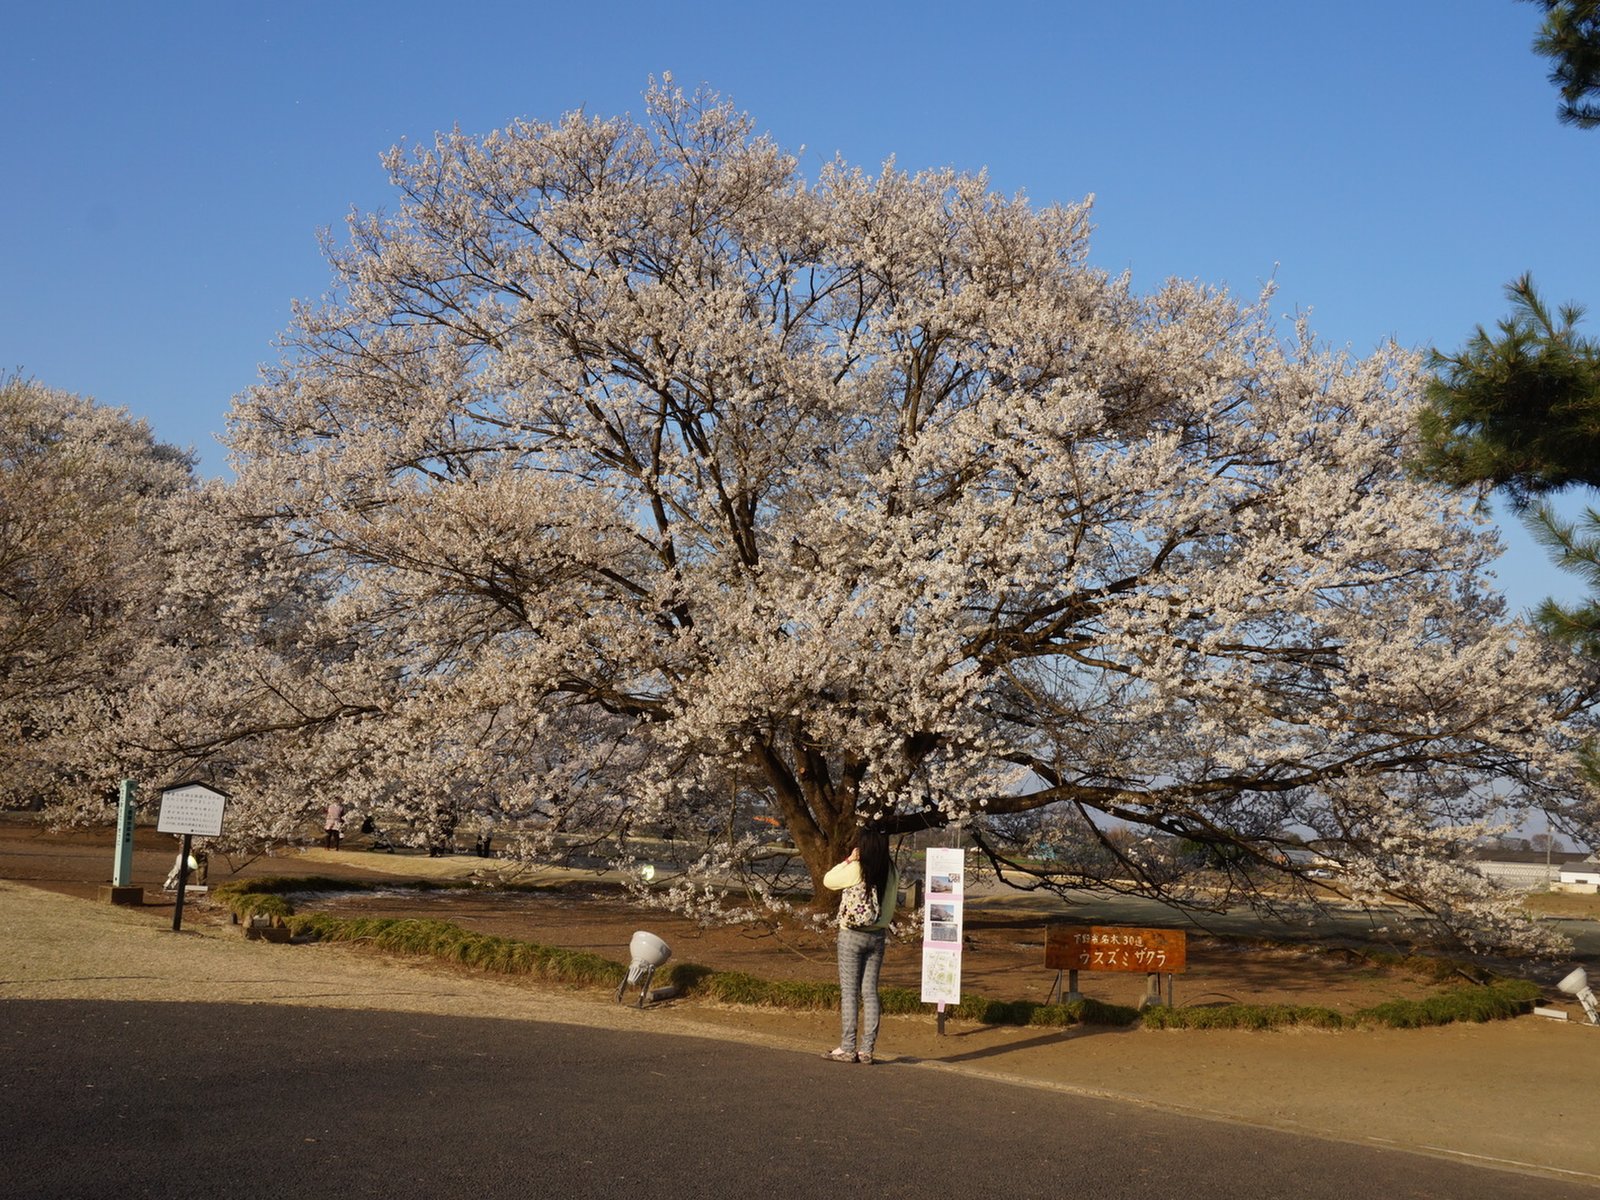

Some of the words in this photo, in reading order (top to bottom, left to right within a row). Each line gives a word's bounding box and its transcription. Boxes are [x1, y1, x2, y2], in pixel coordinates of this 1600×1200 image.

[1079, 947, 1166, 967] ウスズミザクラ
